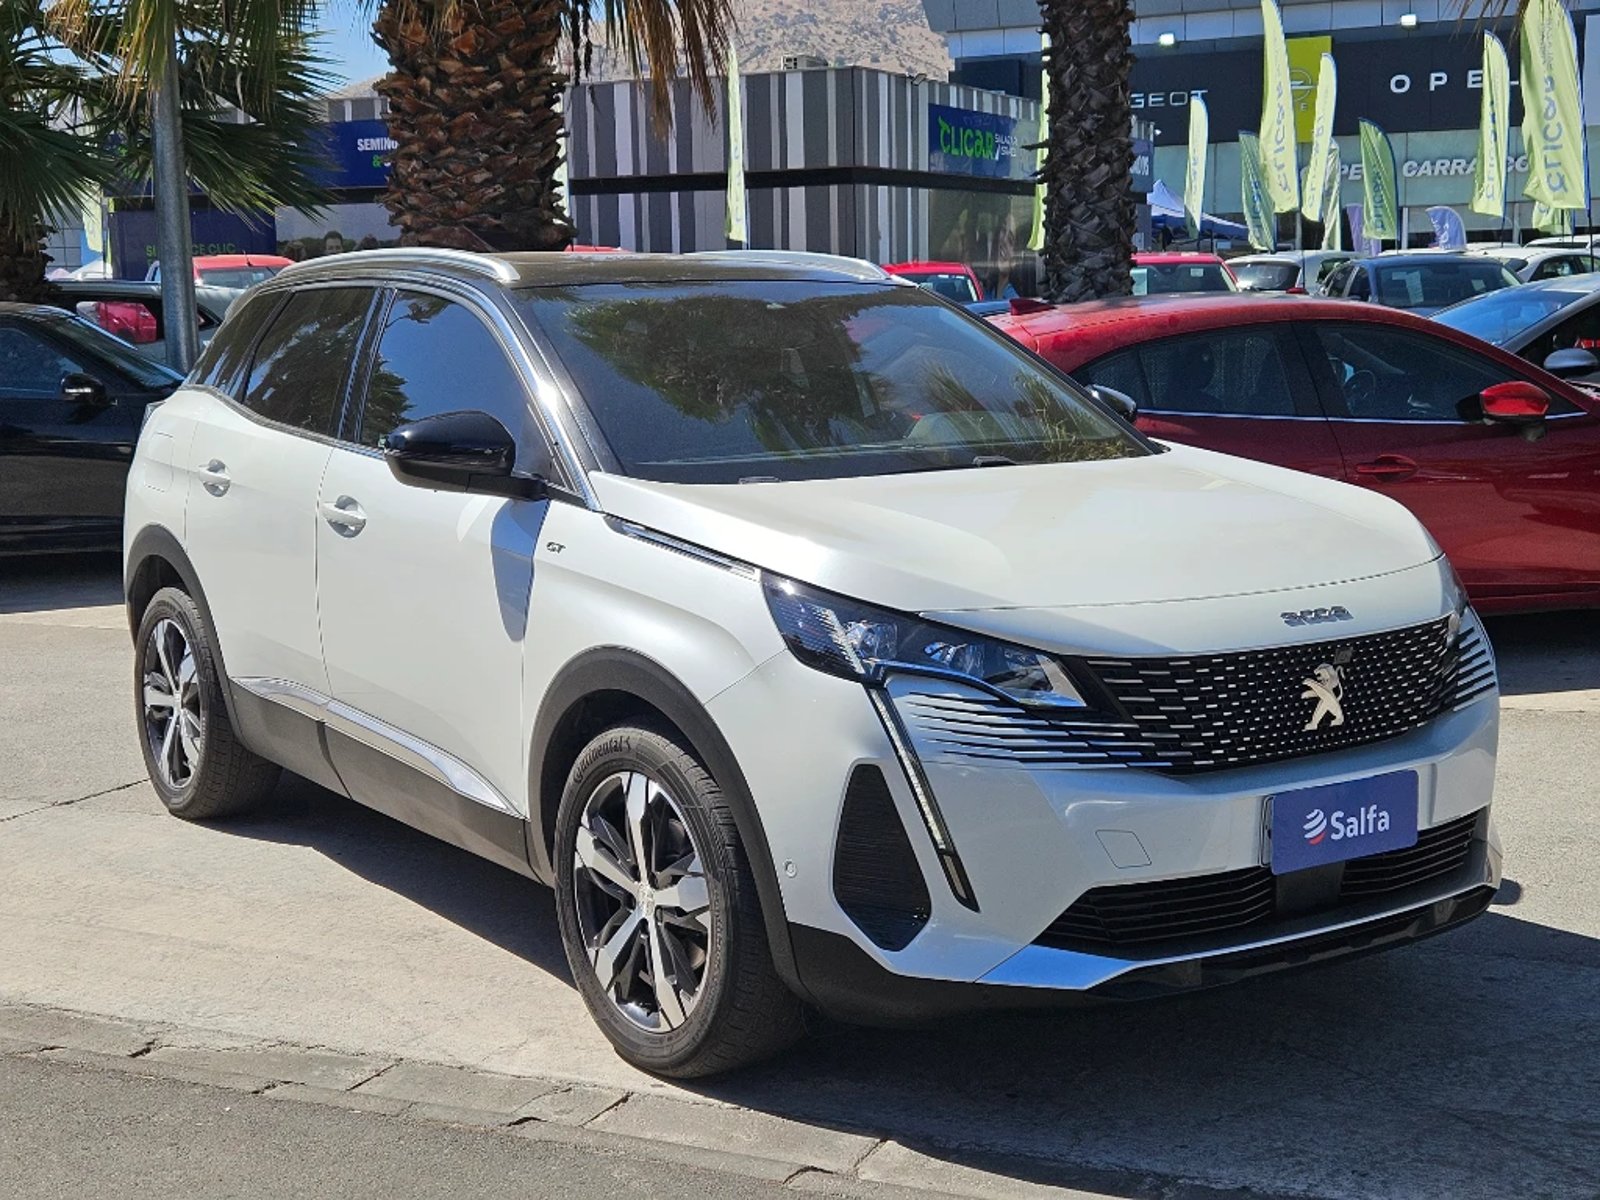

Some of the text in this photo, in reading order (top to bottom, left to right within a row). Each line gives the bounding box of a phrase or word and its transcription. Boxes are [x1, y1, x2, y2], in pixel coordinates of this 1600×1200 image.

[1390, 69, 1519, 93] OPE
[546, 541, 566, 554] GT
[573, 736, 623, 783] Continental
[1330, 804, 1390, 841] Salfa
